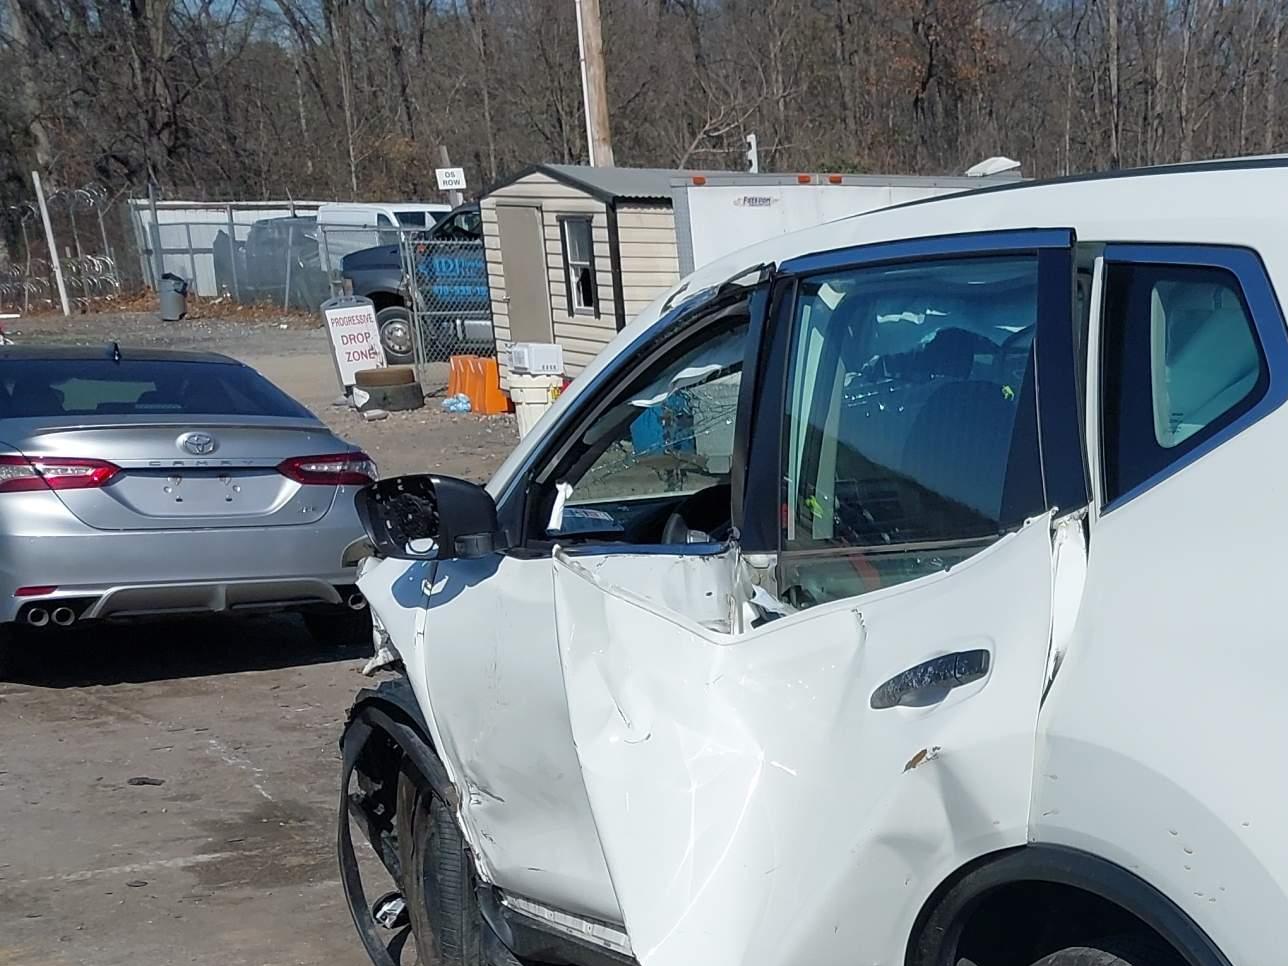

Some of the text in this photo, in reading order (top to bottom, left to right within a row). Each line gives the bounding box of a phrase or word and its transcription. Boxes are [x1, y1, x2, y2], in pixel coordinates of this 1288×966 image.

[442, 179, 461, 187] ROW
[330, 313, 374, 327] PROGRESSIVE
[341, 331, 371, 346] DROP
[345, 348, 376, 362] ZONE
